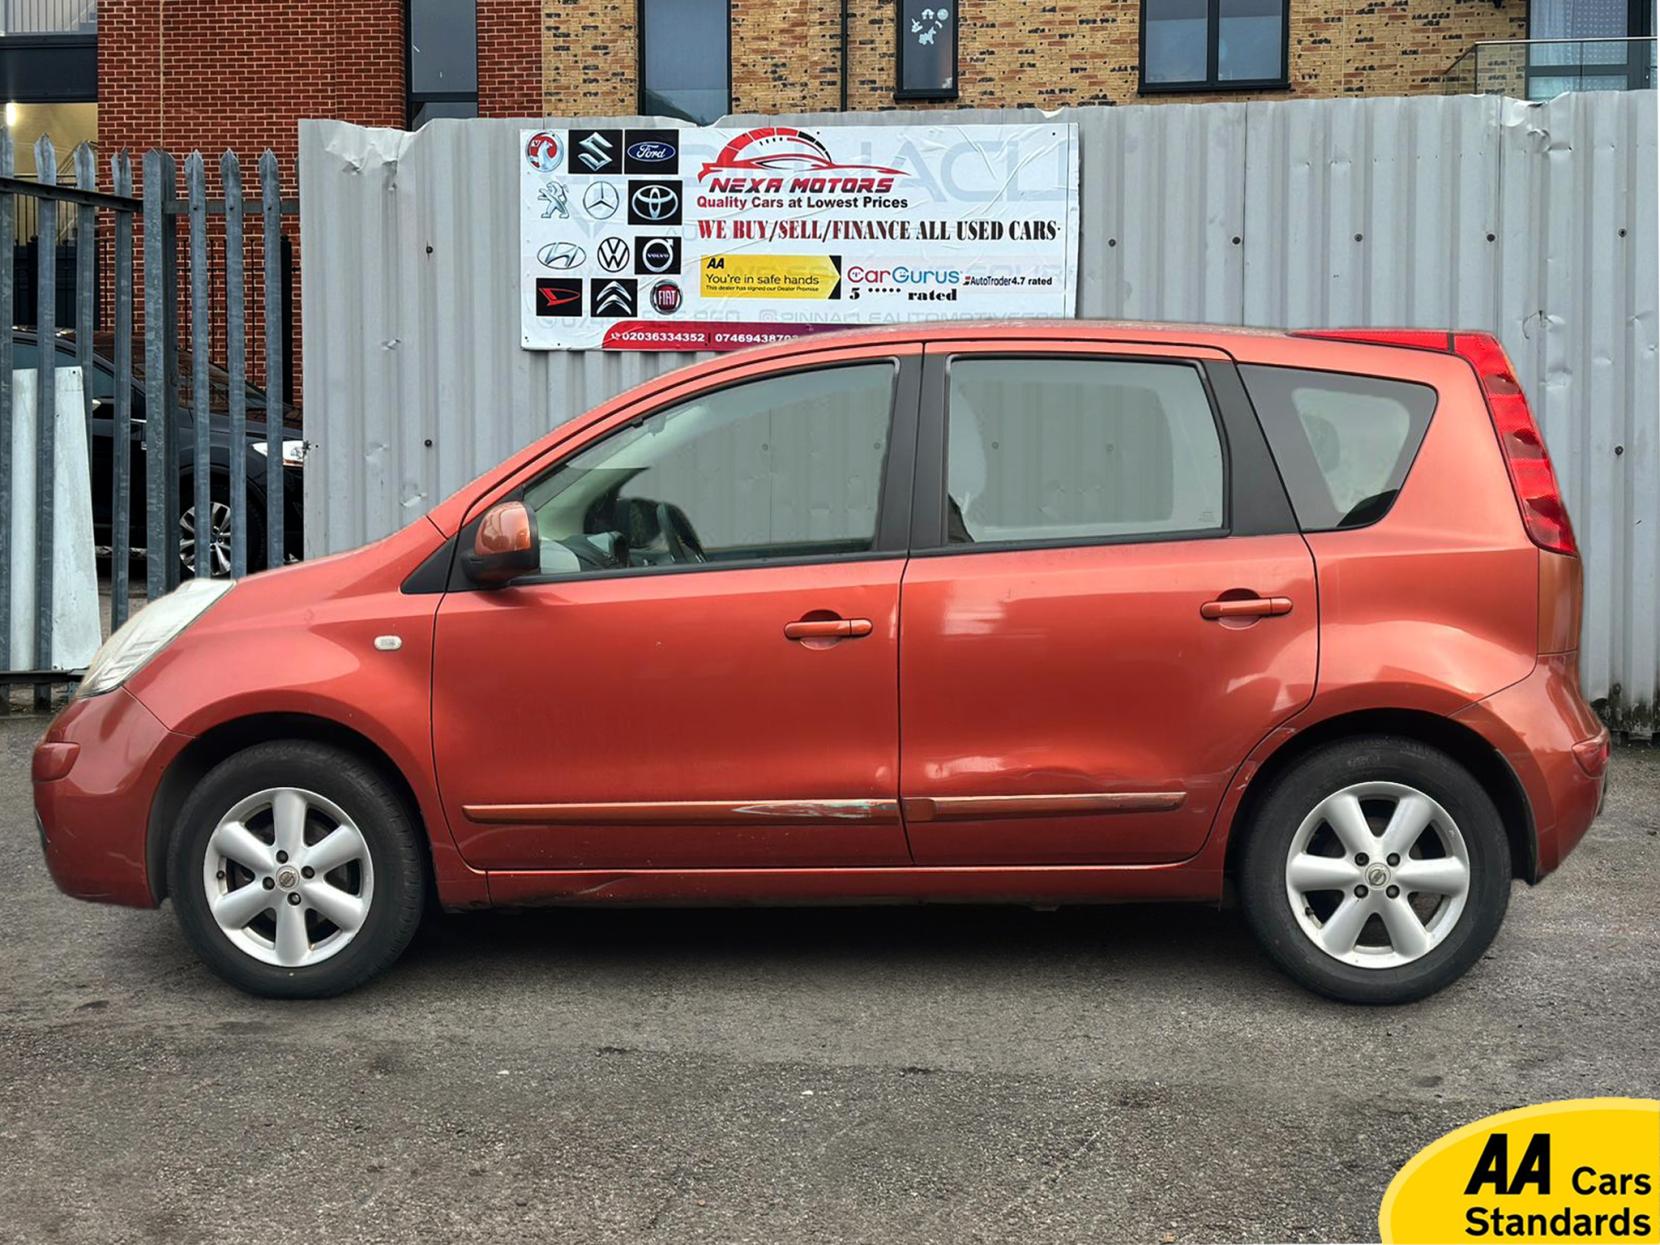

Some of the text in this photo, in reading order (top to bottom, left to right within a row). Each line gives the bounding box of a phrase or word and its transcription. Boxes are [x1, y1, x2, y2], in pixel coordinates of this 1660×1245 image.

[637, 144, 665, 158] Ford
[708, 177, 896, 194] NEXA MOTORS
[697, 196, 908, 211] Quality Cars at Lowest Prices
[698, 219, 728, 240] WE
[732, 219, 911, 243] BUY/SELL/FINANCE
[915, 220, 953, 241] ALL
[956, 219, 1005, 241] USED
[1008, 219, 1057, 241] CARS
[706, 257, 725, 269] AA
[705, 273, 741, 284] You're
[744, 273, 754, 284] in
[757, 274, 782, 285] safe
[784, 274, 820, 285] hands
[847, 266, 961, 284] CarGurus
[1028, 276, 1053, 286] rated
[658, 290, 677, 306] FIAT
[849, 286, 958, 301] 5 rated
[622, 333, 705, 343] 02036334352
